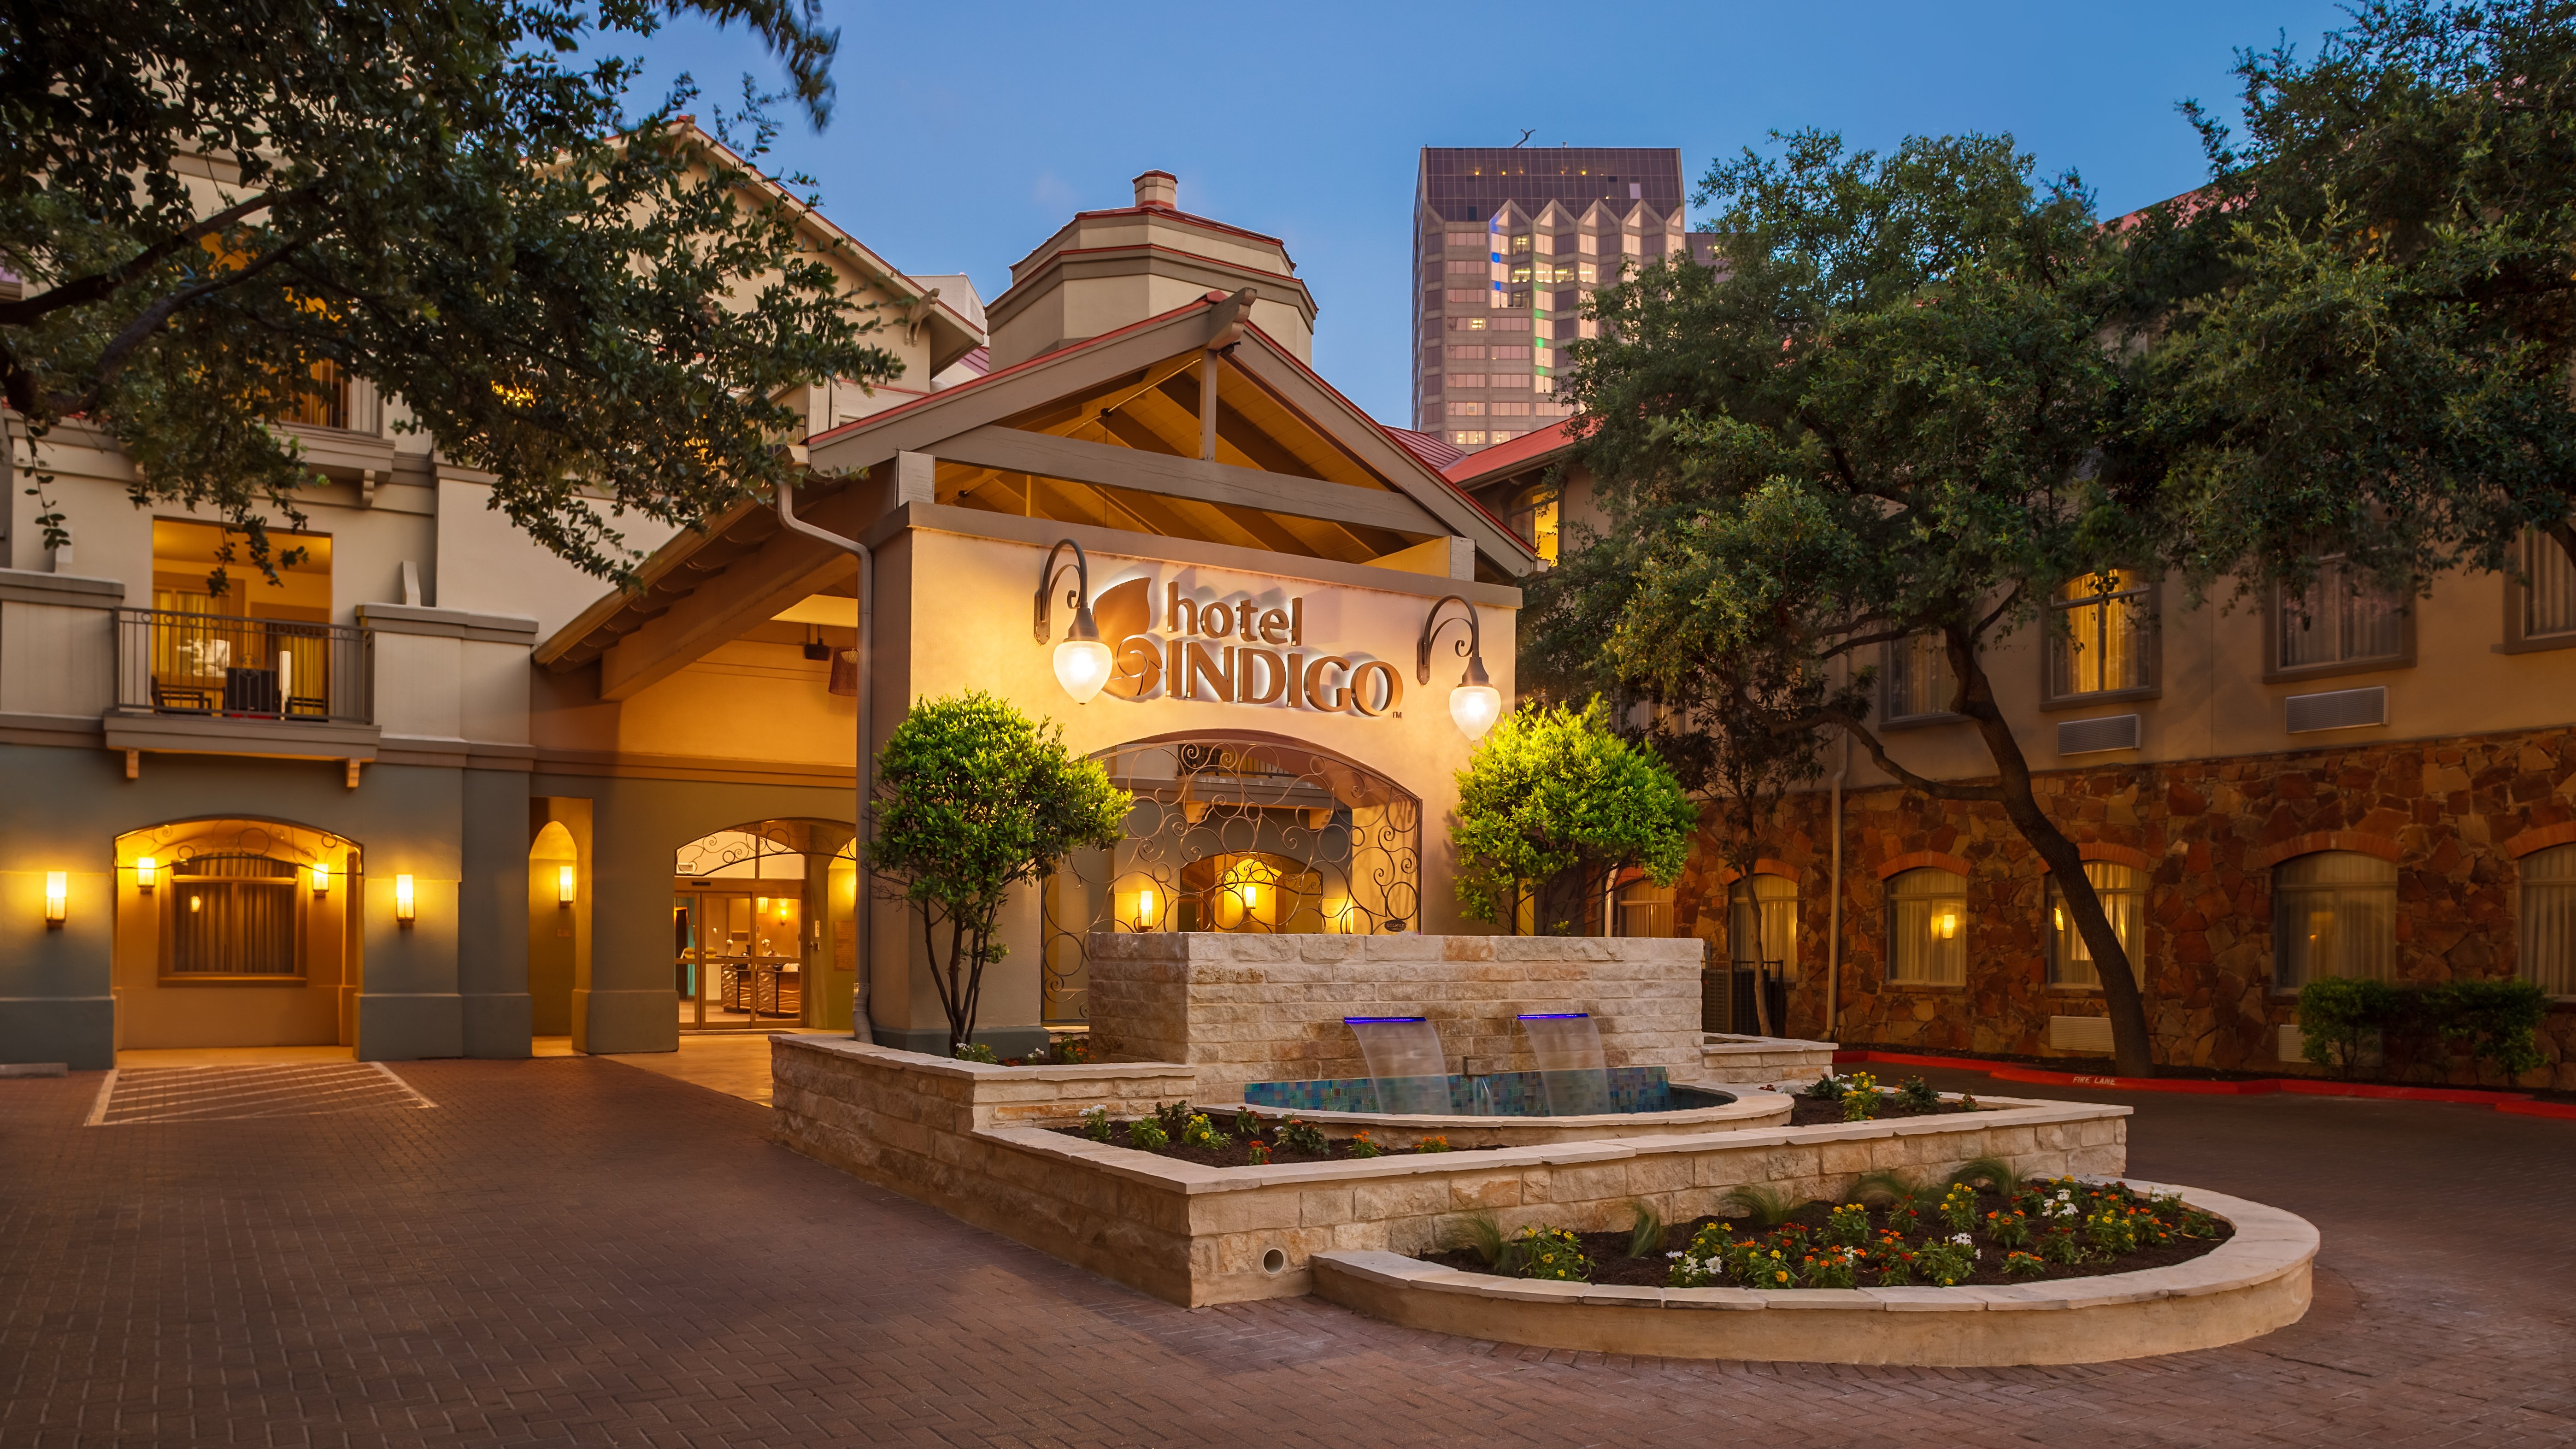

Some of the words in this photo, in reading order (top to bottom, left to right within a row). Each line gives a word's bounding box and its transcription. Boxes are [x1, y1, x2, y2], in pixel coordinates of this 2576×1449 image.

[1167, 581, 1303, 646] hotel
[1166, 640, 1403, 717] INDIGO
[2094, 1077, 2116, 1085] LANE
